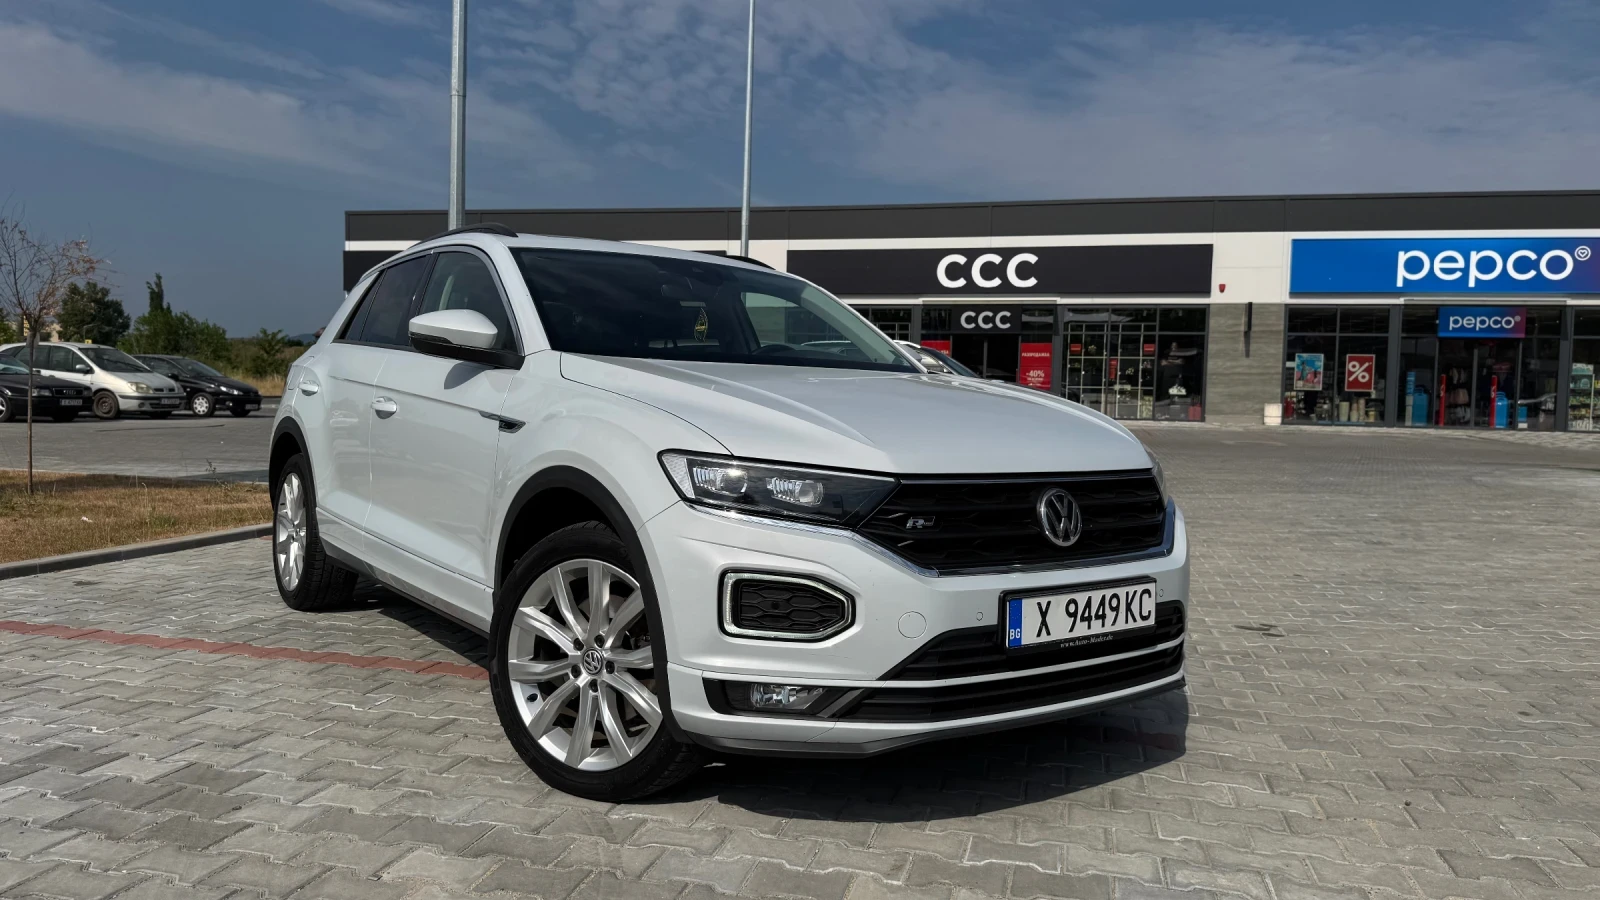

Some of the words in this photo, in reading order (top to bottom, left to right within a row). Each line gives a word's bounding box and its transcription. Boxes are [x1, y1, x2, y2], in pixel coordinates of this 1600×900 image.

[936, 252, 1039, 288] CCC
[1396, 249, 1574, 287] pepco
[960, 311, 1011, 329] CCC
[1449, 314, 1515, 331] pepco
[1036, 600, 1052, 638] X
[1009, 628, 1021, 640] BG
